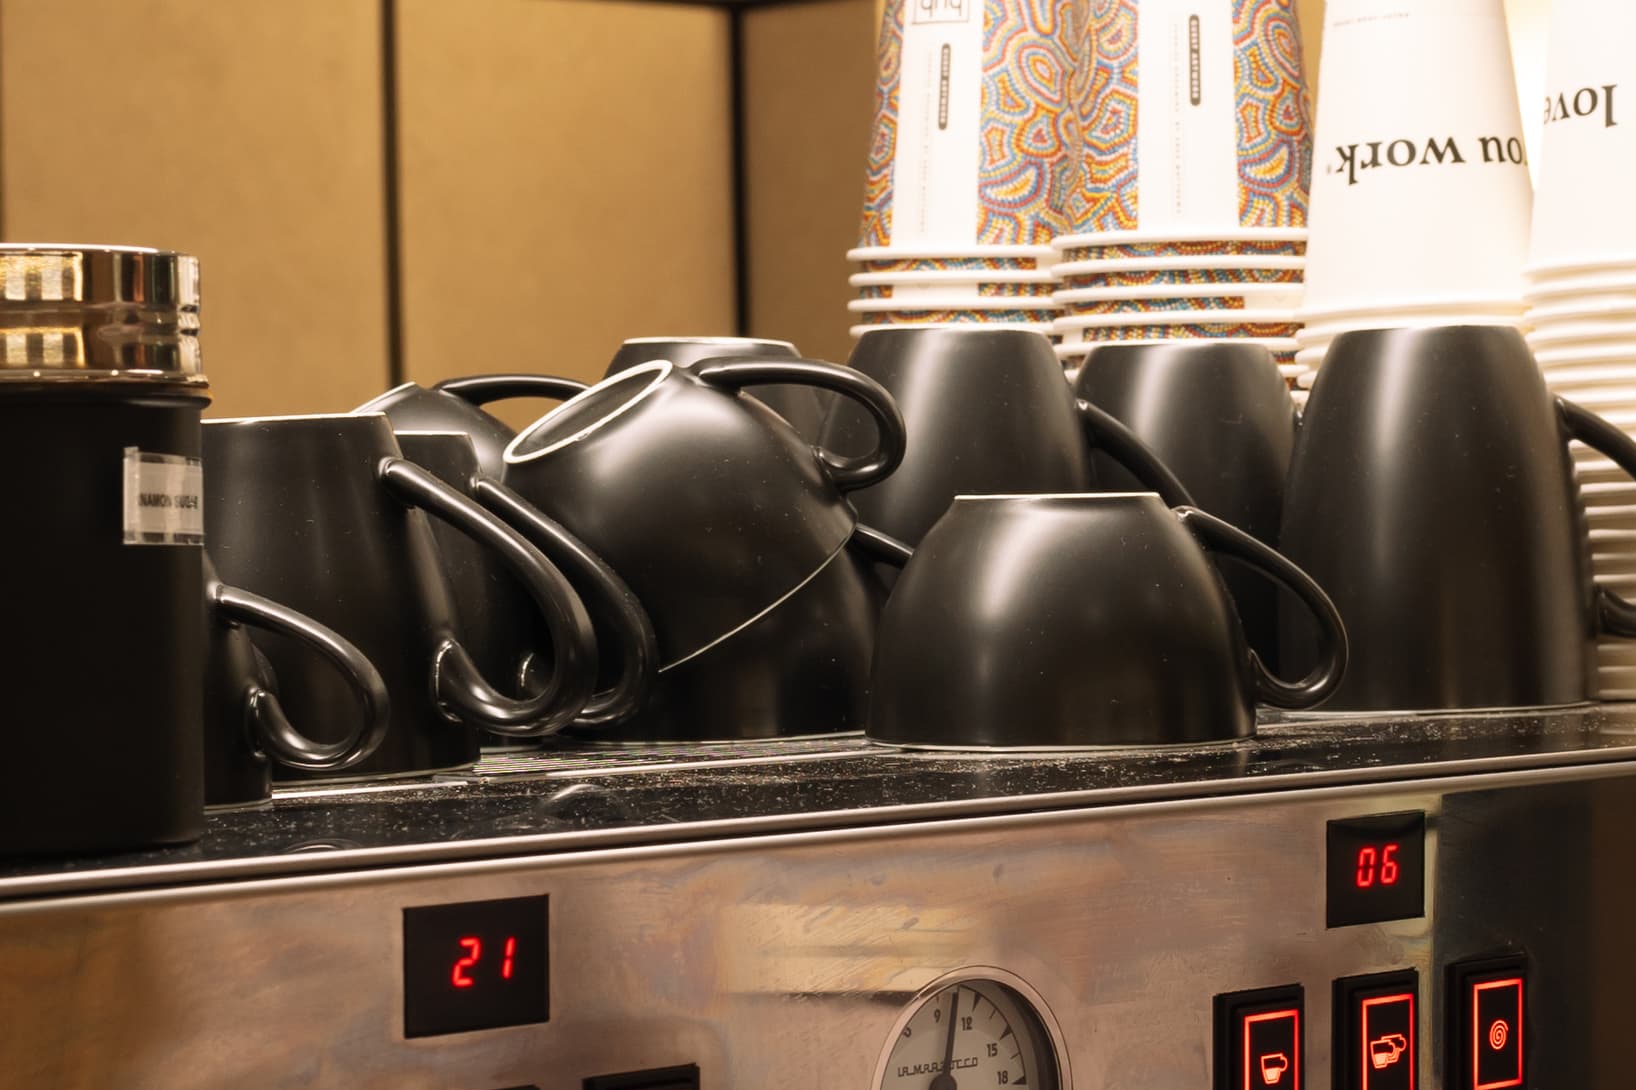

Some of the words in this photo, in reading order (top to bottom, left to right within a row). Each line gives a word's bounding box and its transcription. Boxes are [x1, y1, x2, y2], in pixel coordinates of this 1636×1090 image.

[1543, 84, 1618, 128] love
[1478, 136, 1529, 167] ou
[1356, 844, 1400, 888] 06
[452, 937, 516, 988] 21
[933, 1008, 941, 1024] 9
[961, 1016, 973, 1031] 12
[986, 1043, 998, 1058] 15
[997, 1071, 1009, 1085] 18
